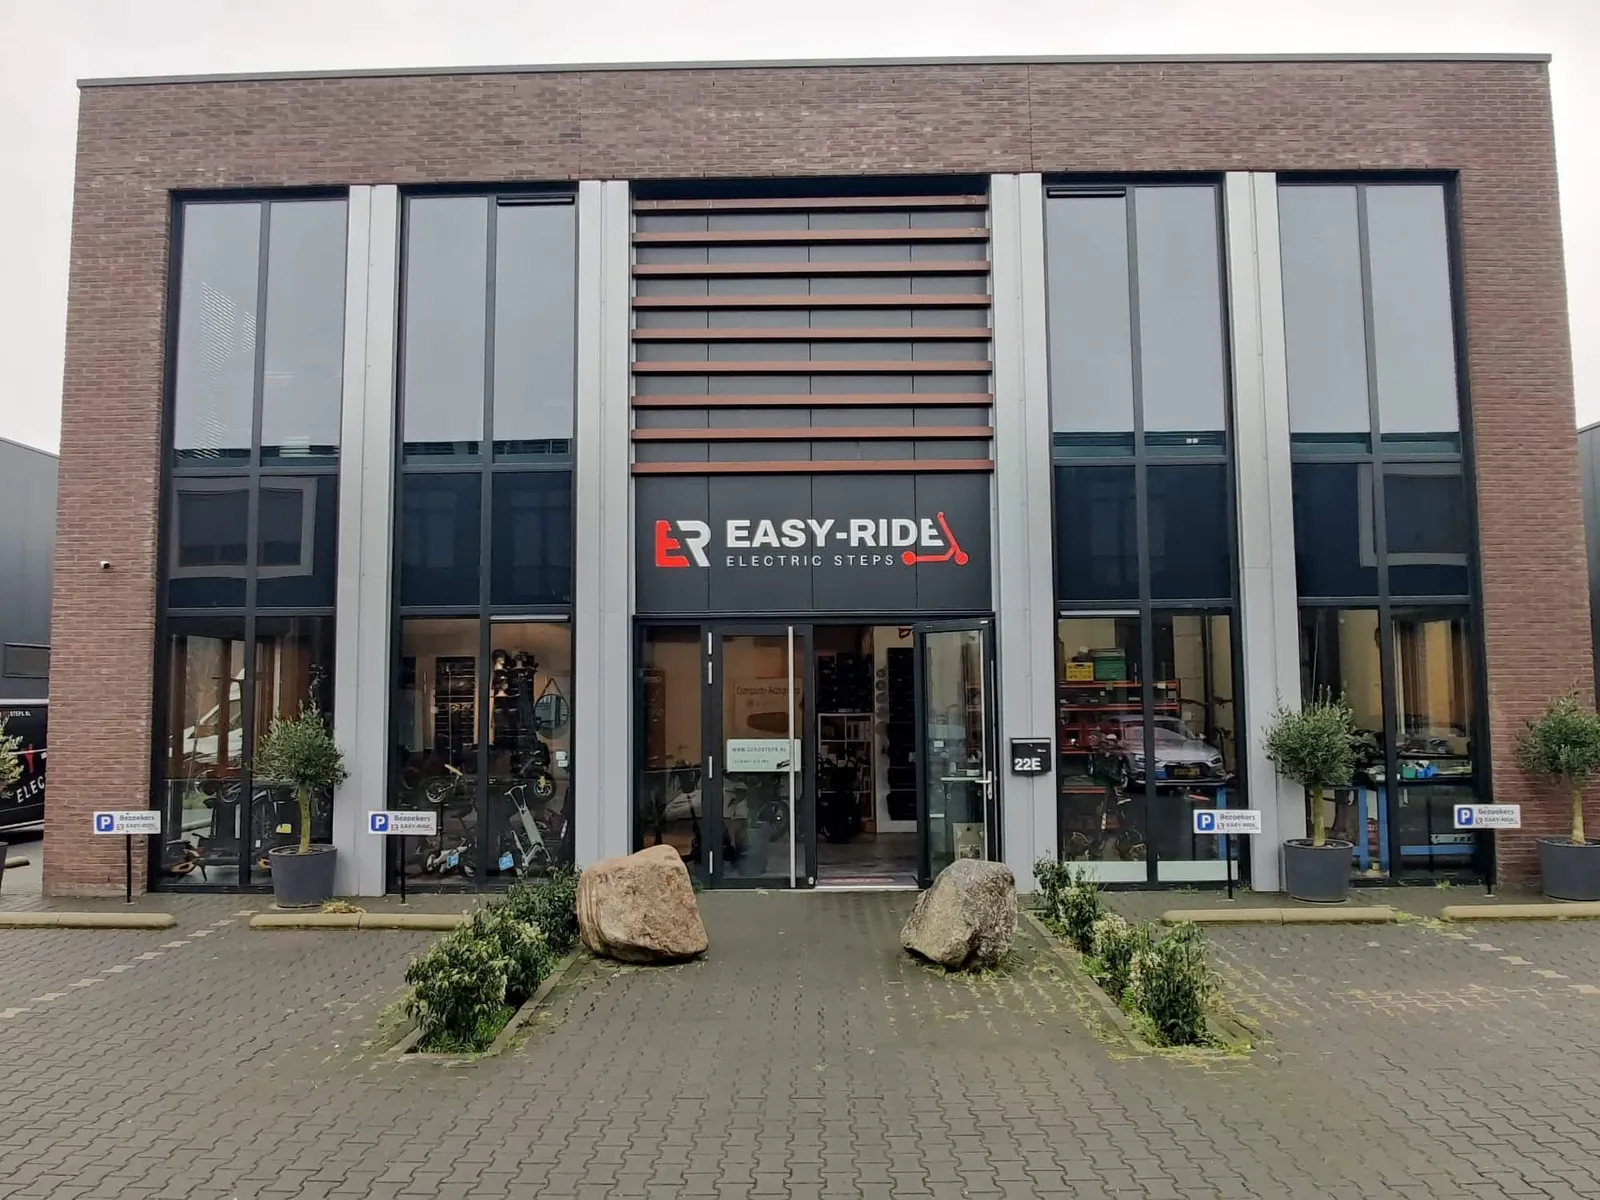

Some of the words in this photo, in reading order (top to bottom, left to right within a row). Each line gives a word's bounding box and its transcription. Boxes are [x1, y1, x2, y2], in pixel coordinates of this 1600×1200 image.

[726, 518, 944, 548] EASY-RIDE
[726, 555, 822, 567] ELECTRIC
[833, 555, 895, 567] STEPS
[1014, 757, 1042, 771] 22E
